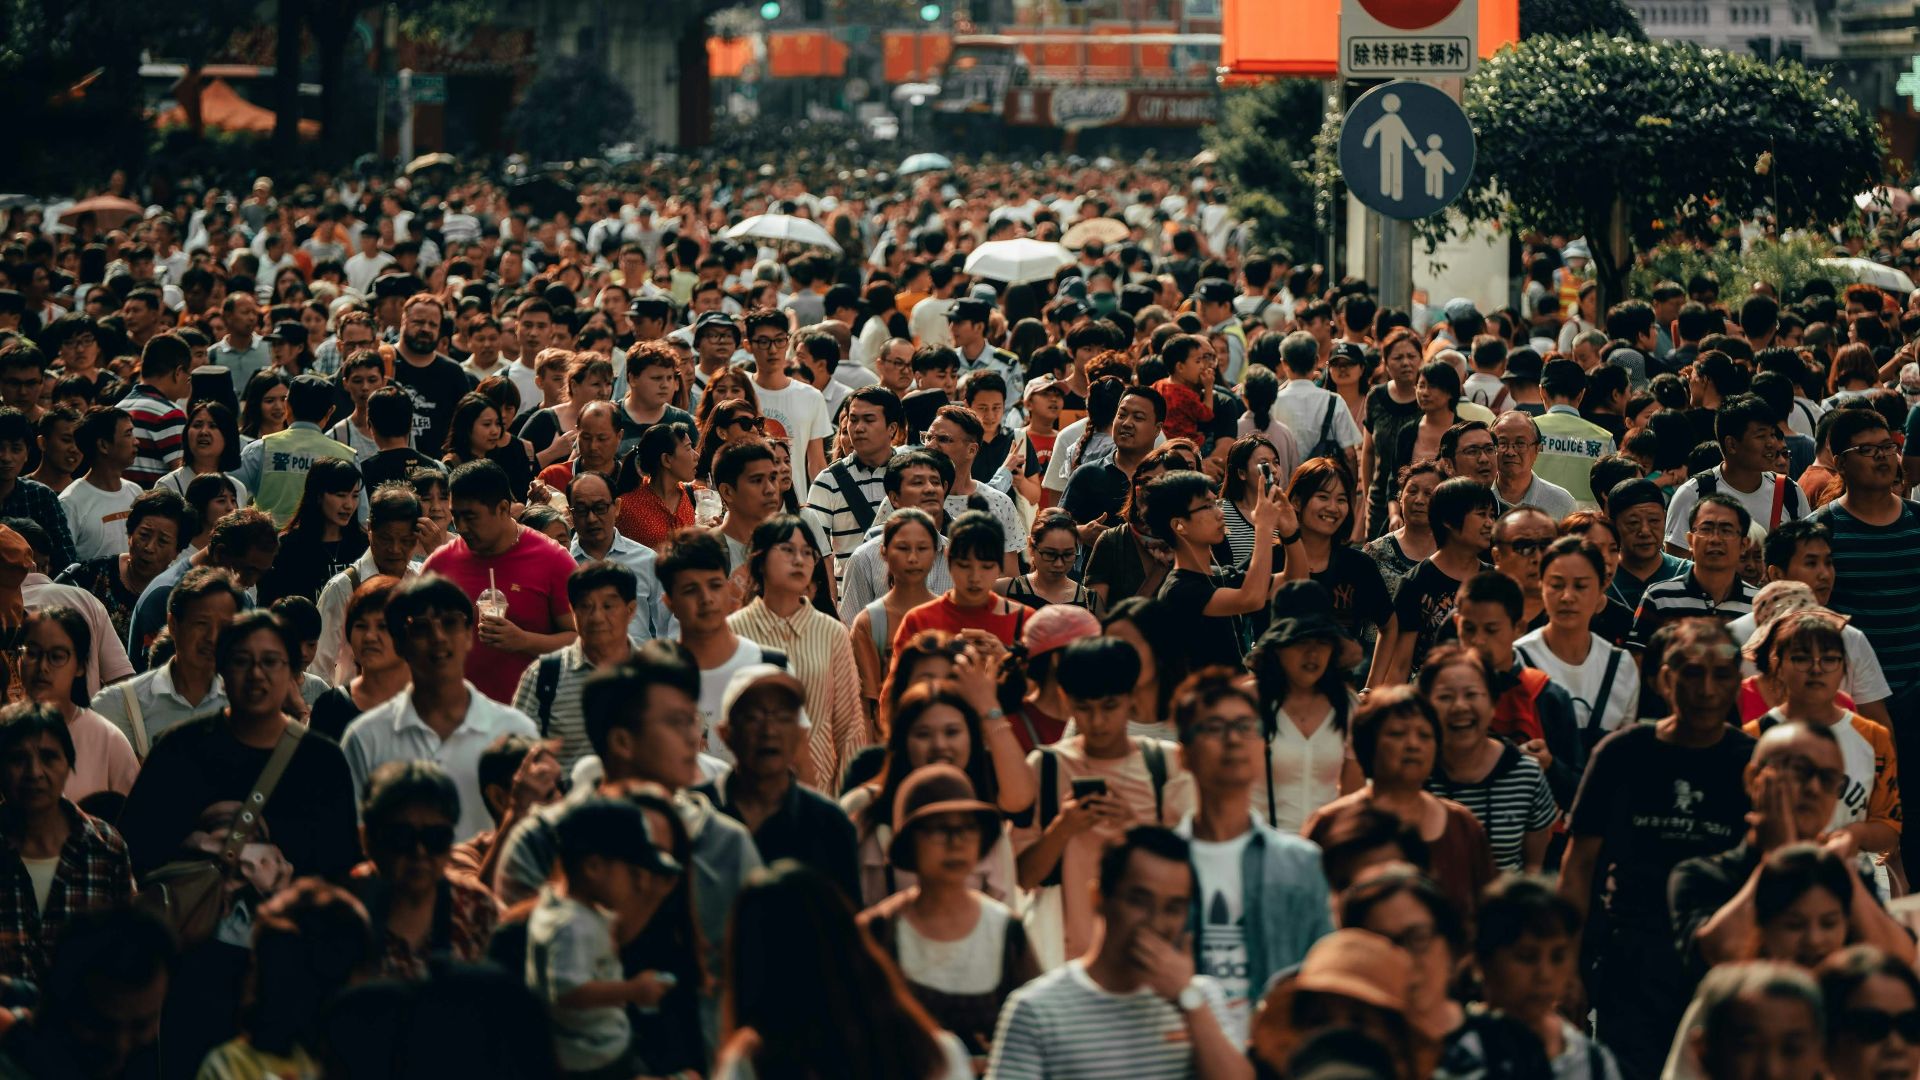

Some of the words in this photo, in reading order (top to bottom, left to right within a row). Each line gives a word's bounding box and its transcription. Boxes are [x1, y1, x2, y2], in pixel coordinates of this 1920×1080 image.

[1354, 42, 1463, 65] 除特种车辆外
[1549, 439, 1583, 453] POLICE
[1586, 440, 1602, 457] 察
[273, 452, 290, 471] 警
